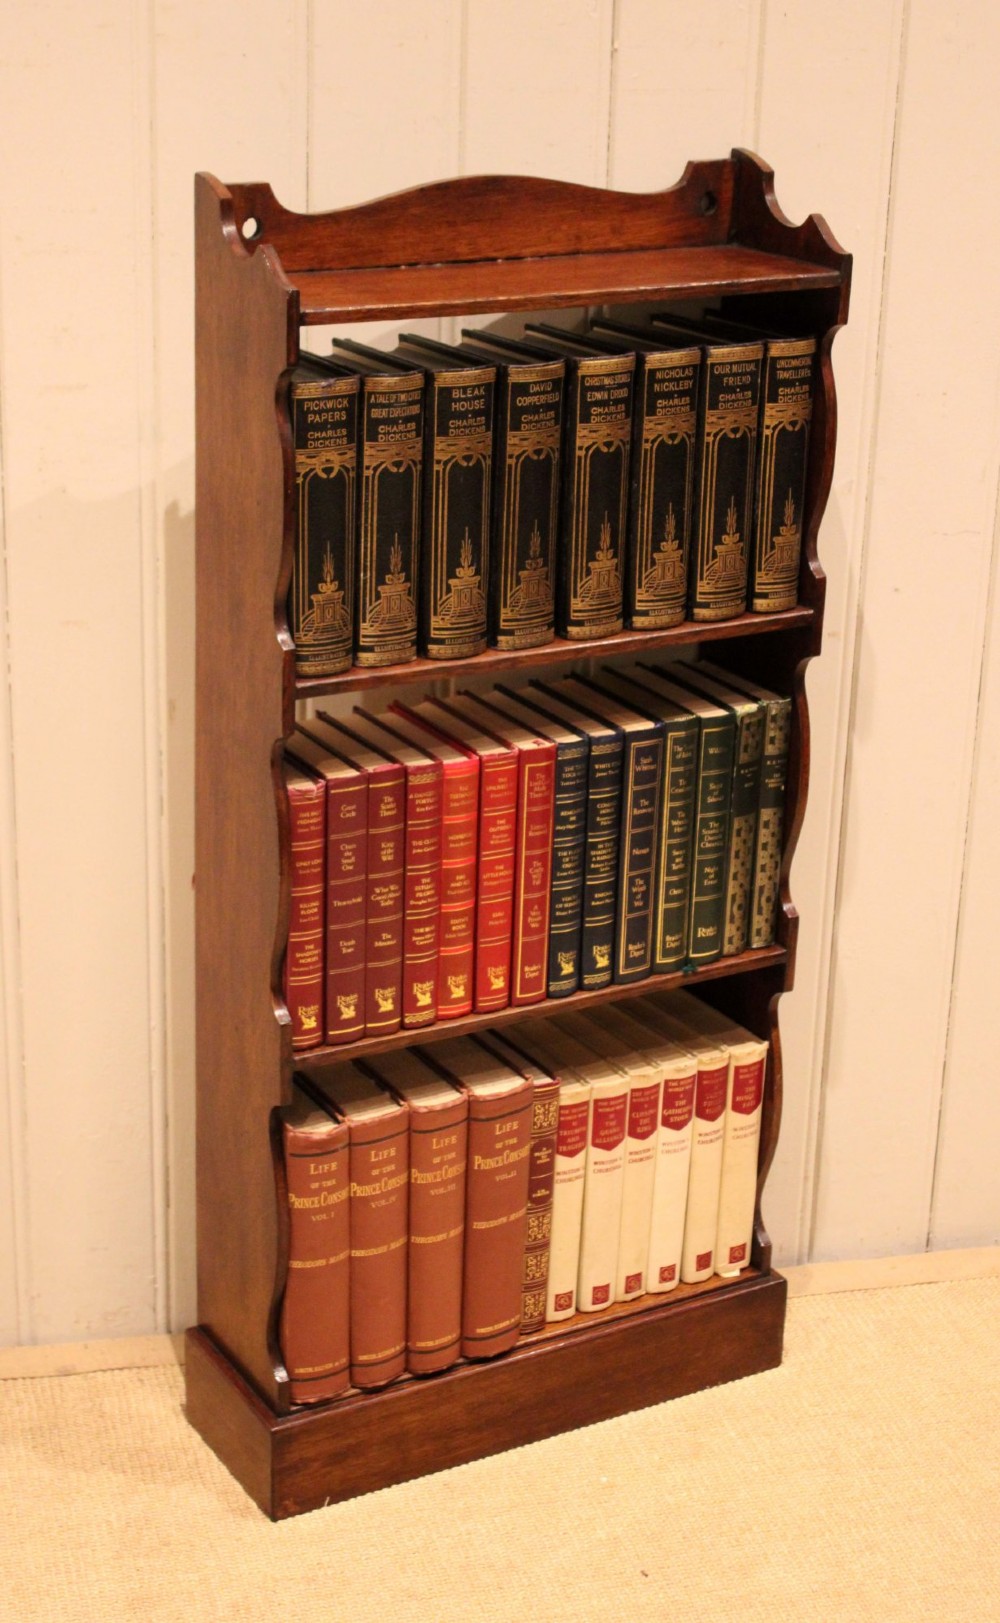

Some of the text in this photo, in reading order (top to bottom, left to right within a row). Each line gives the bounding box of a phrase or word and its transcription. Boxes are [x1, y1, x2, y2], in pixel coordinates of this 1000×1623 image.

[655, 367, 694, 380] NICHOLAS
[713, 362, 756, 375] OUR MUTUAL
[584, 375, 615, 386] CHRISTMAS
[654, 379, 693, 392] NICKLEBY
[723, 375, 751, 387] FRIEND
[452, 386, 485, 398] BLEAK
[529, 381, 553, 393] DAVID
[778, 384, 809, 395] CHARLES
[370, 394, 376, 403] A
[375, 393, 389, 403] TALE
[516, 392, 560, 406] COPPERFIELD
[587, 387, 629, 402] EDWIN DROOD
[719, 390, 752, 401] CHARLES
[778, 393, 809, 404] DICKENS
[304, 398, 349, 411] PICKWICK
[451, 399, 485, 411] HOUSE
[656, 397, 690, 408] CHARLES
[718, 399, 752, 410] DICKENS
[371, 408, 388, 418] GREAT
[591, 404, 626, 415] CHARLES
[656, 405, 690, 416] DICKENS
[308, 411, 347, 424] PAPERS
[449, 416, 485, 428] CHARLES
[521, 411, 555, 422] CHARLES
[590, 412, 626, 423] DICKENS
[378, 422, 416, 433] CHARLES
[449, 425, 486, 436] DICKENS
[521, 420, 555, 431] DICKENS
[307, 428, 348, 439] CHARLES
[378, 431, 416, 442] DICKENS
[308, 437, 348, 448] DICKENS
[495, 1121, 519, 1135] LIFE
[432, 1135, 457, 1149] LIFE
[505, 1137, 518, 1146] THE
[370, 1148, 396, 1162] LIFE
[474, 1155, 503, 1170] PRINCE
[310, 1162, 338, 1175] LIFE
[411, 1168, 442, 1184] PRINCE
[322, 1179, 336, 1187] THE
[350, 1182, 381, 1197] PRINCE
[288, 1193, 320, 1209] PRINCE
